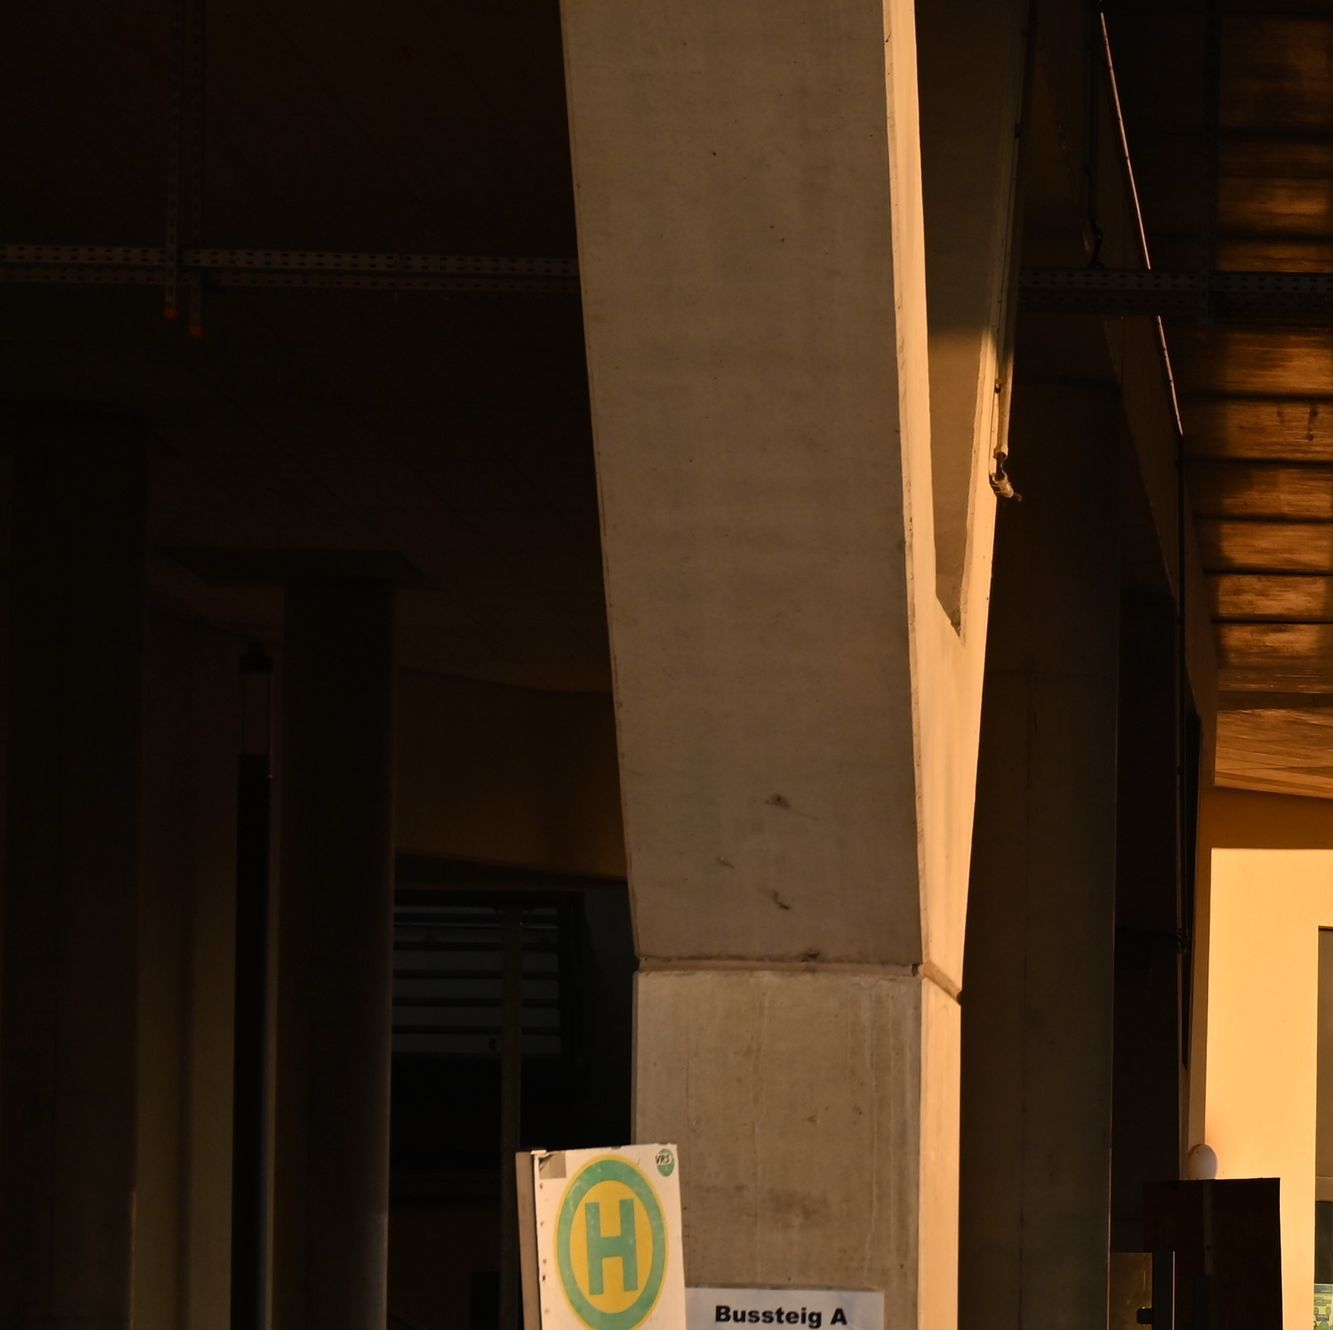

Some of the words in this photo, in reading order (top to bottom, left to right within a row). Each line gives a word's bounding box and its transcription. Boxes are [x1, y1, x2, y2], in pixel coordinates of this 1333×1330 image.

[655, 1153, 672, 1166] VRS
[585, 1198, 638, 1296] H
[715, 1305, 822, 1329] Bussteig
[829, 1308, 848, 1325] A
